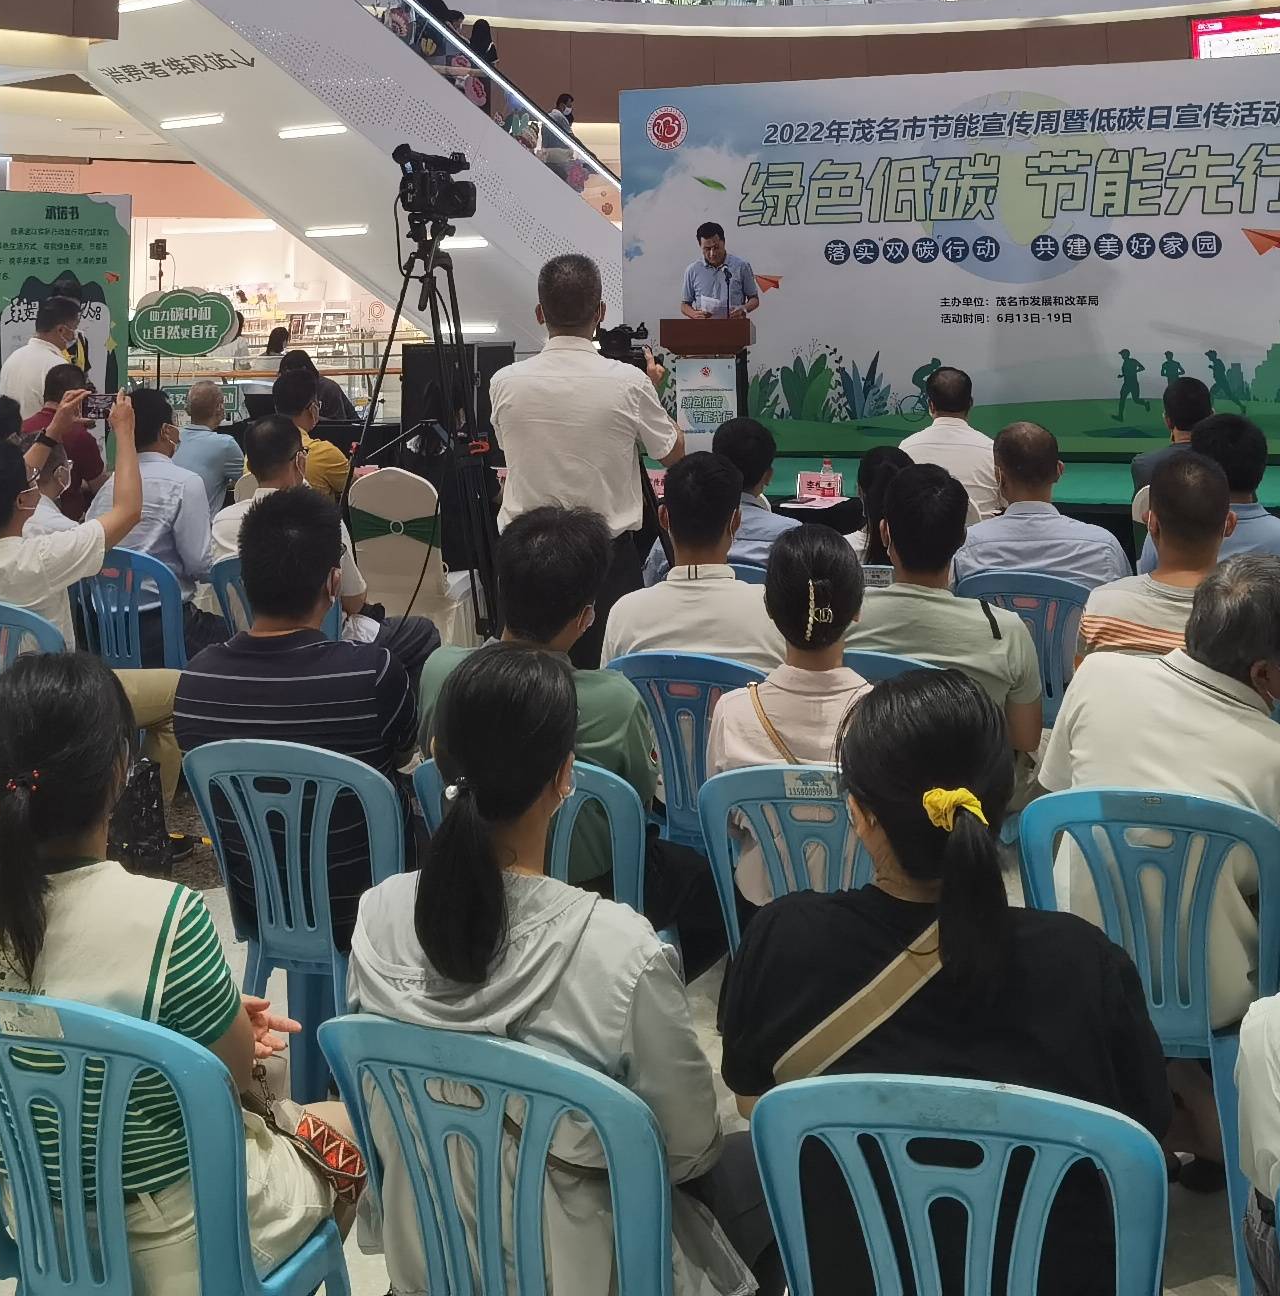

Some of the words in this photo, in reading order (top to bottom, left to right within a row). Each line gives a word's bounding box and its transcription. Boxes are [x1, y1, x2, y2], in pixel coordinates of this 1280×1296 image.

[101, 50, 234, 84] 消费者维权站
[737, 153, 1001, 227] 绿色低碳
[45, 205, 79, 220] 承诺书
[1034, 232, 1221, 261] 共建美好家园
[149, 306, 211, 322] 助力碳中和
[143, 324, 218, 340] 让自然更自在
